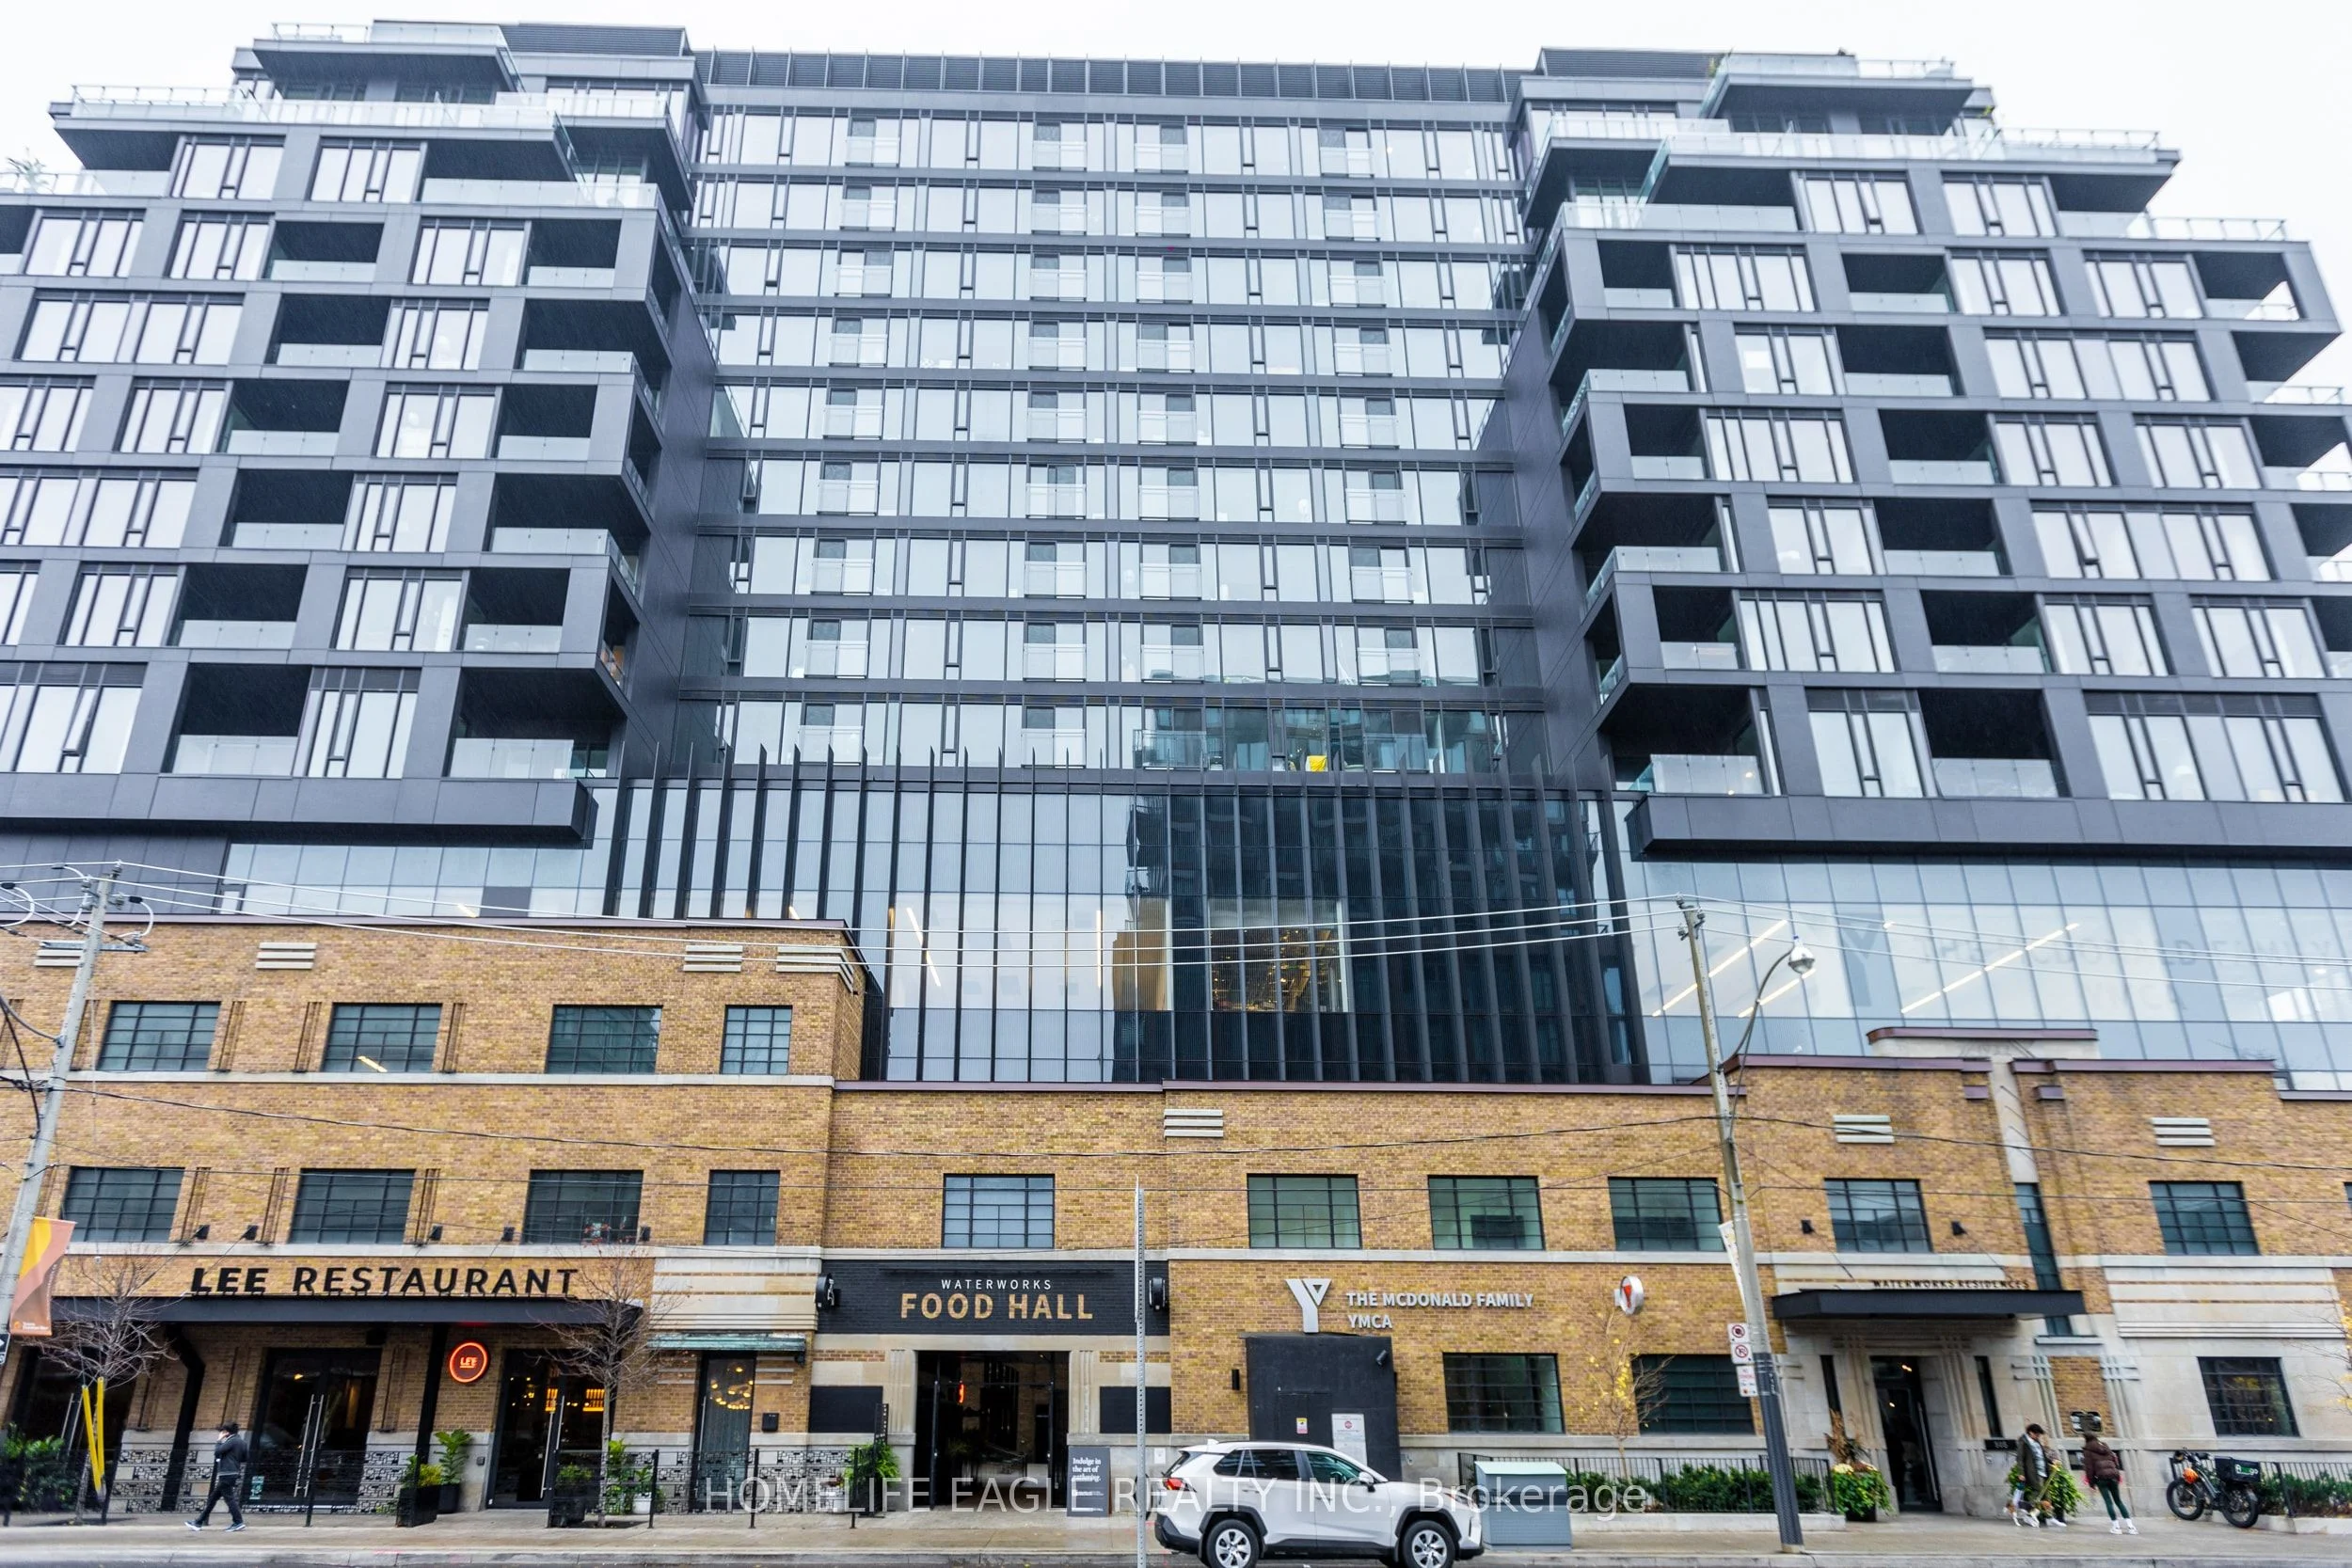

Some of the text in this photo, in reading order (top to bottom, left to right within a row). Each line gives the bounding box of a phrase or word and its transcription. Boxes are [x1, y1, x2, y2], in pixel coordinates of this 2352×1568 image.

[190, 1267, 578, 1294] LEE RESTAURANT
[941, 1279, 1052, 1290] WATERWORKS
[1873, 1279, 1956, 1289] WATERWORKS
[900, 1292, 1093, 1319] FOOD HALL
[1346, 1292, 1534, 1307] THE MCDONALD FAMILY
[1347, 1314, 1392, 1329] YMCA
[460, 1356, 478, 1365] LEE
